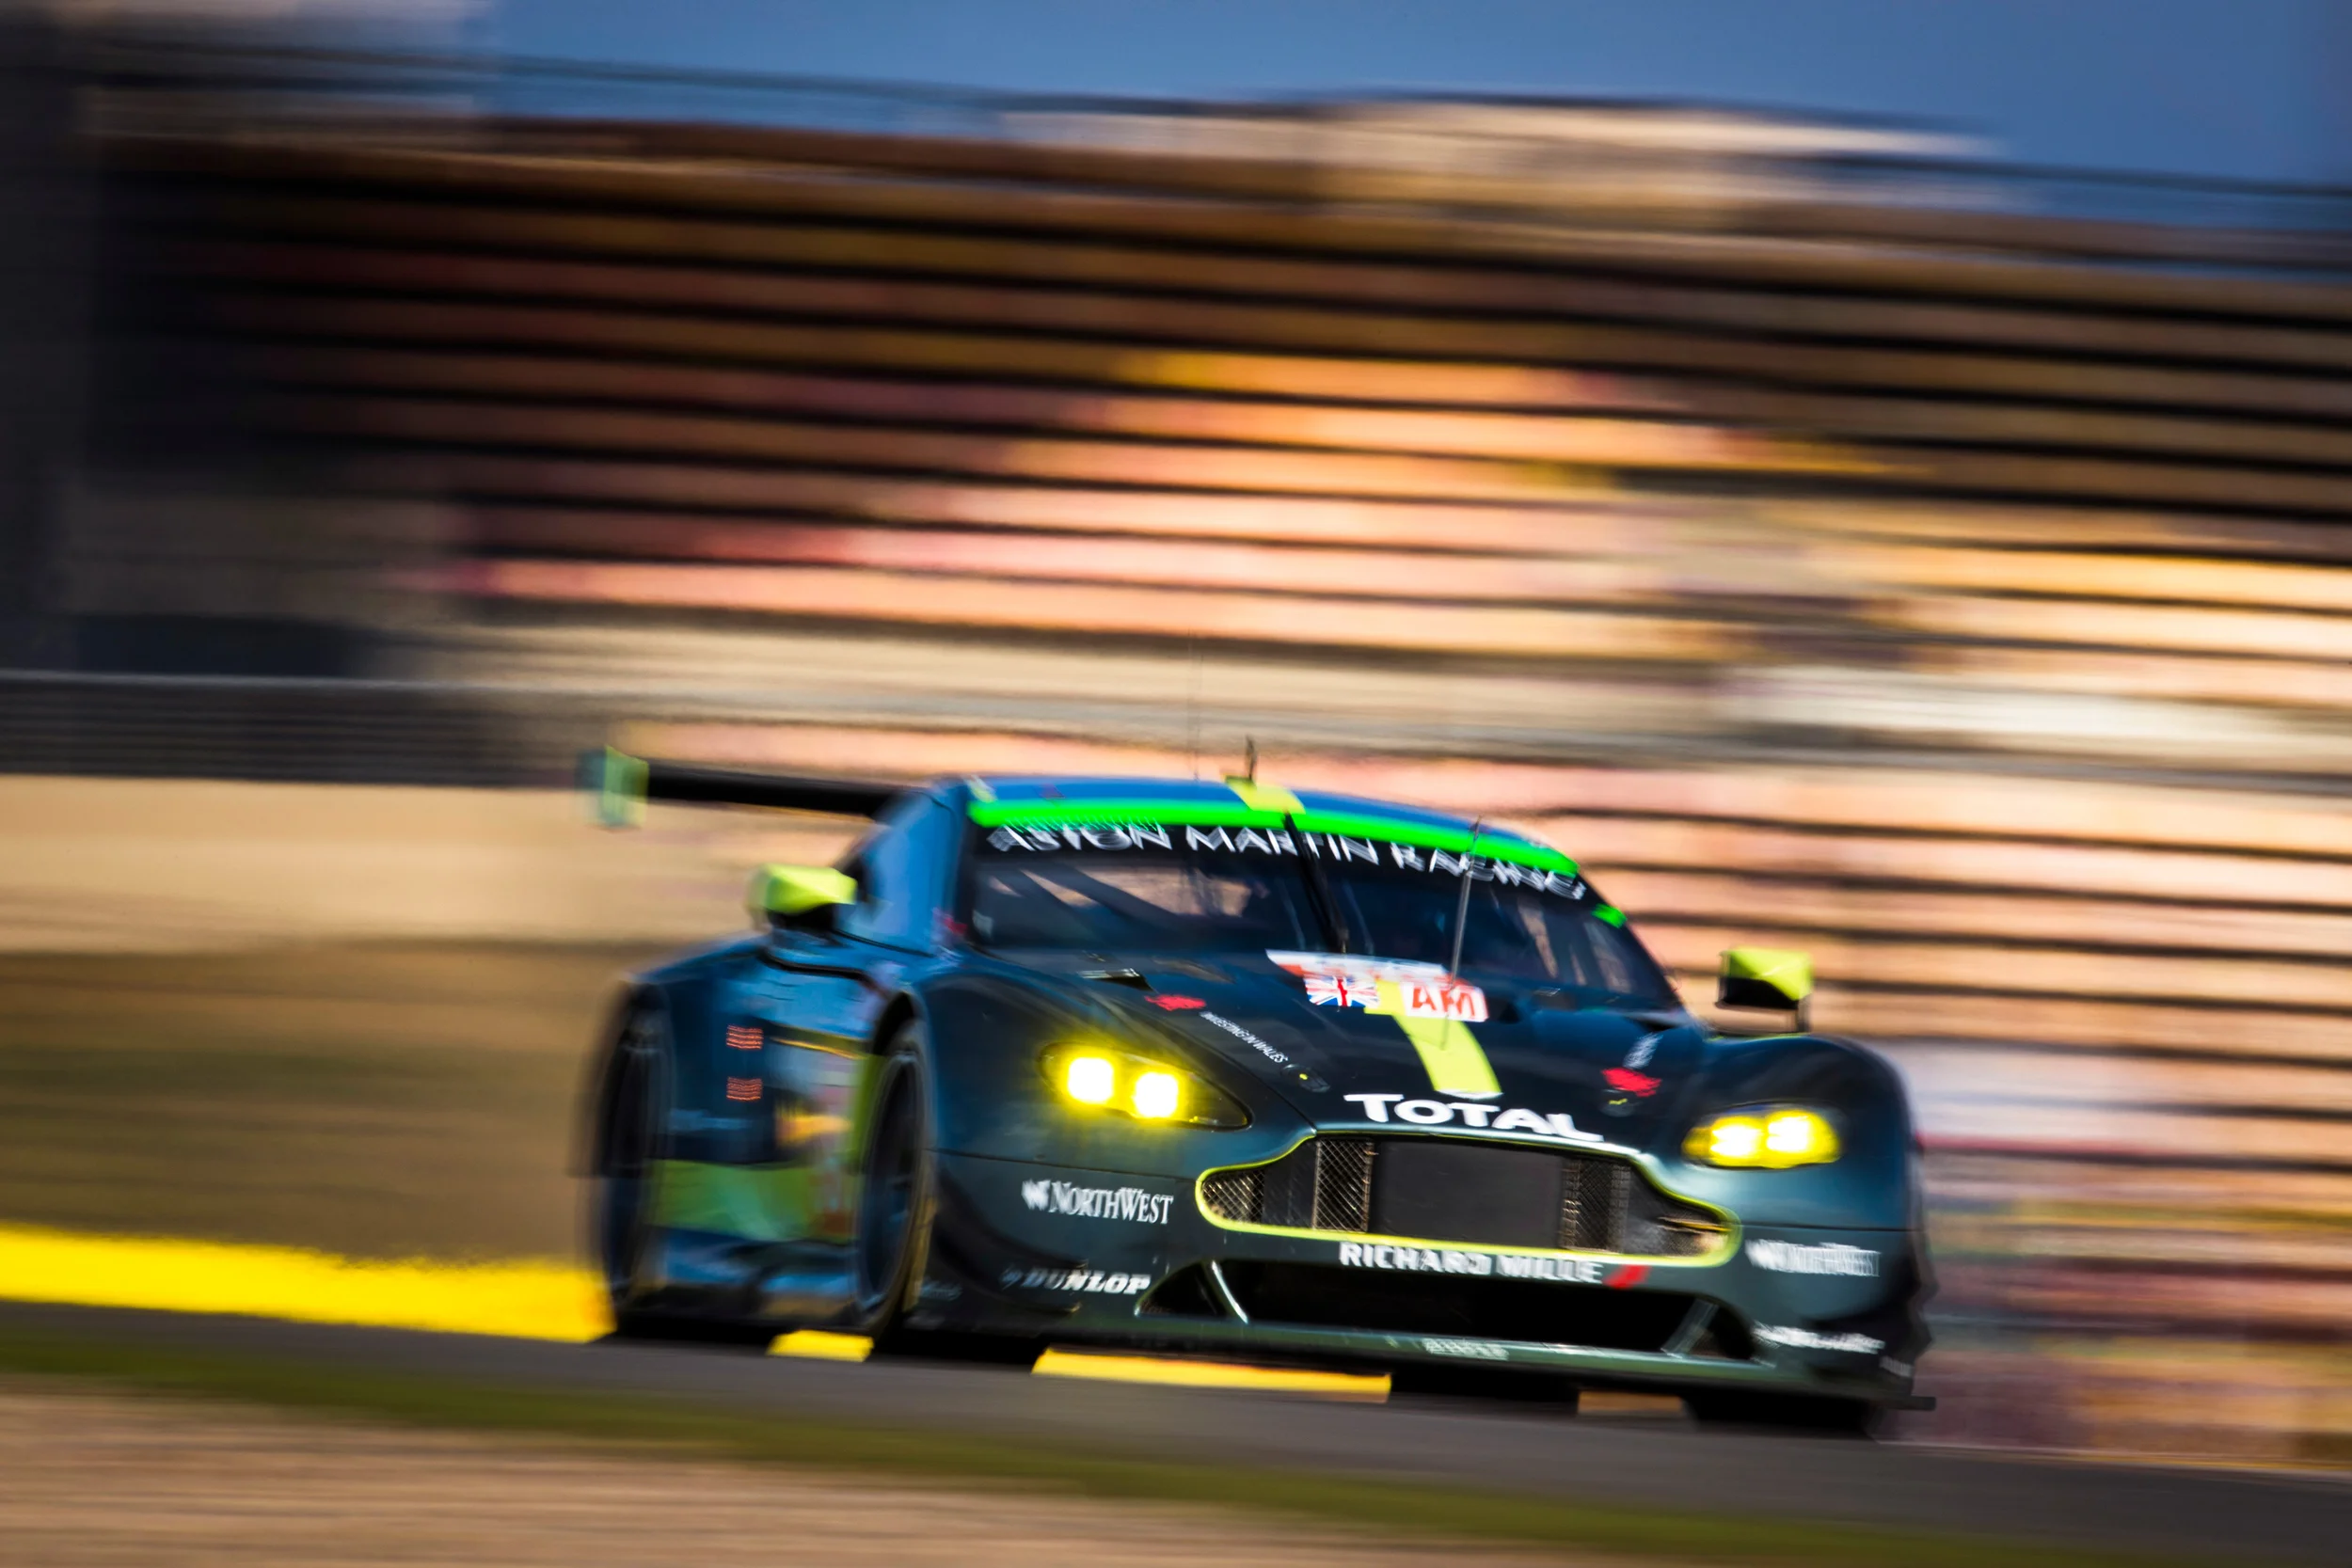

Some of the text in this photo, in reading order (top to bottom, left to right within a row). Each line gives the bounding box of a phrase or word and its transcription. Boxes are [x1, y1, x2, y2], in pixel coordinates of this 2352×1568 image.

[987, 823, 1172, 851] ASTON
[1412, 987, 1477, 1019] AM
[1343, 1094, 1604, 1142] TOTAL
[1339, 1241, 1493, 1276] RICHARD
[1022, 1266, 1152, 1295] DUNLOP
